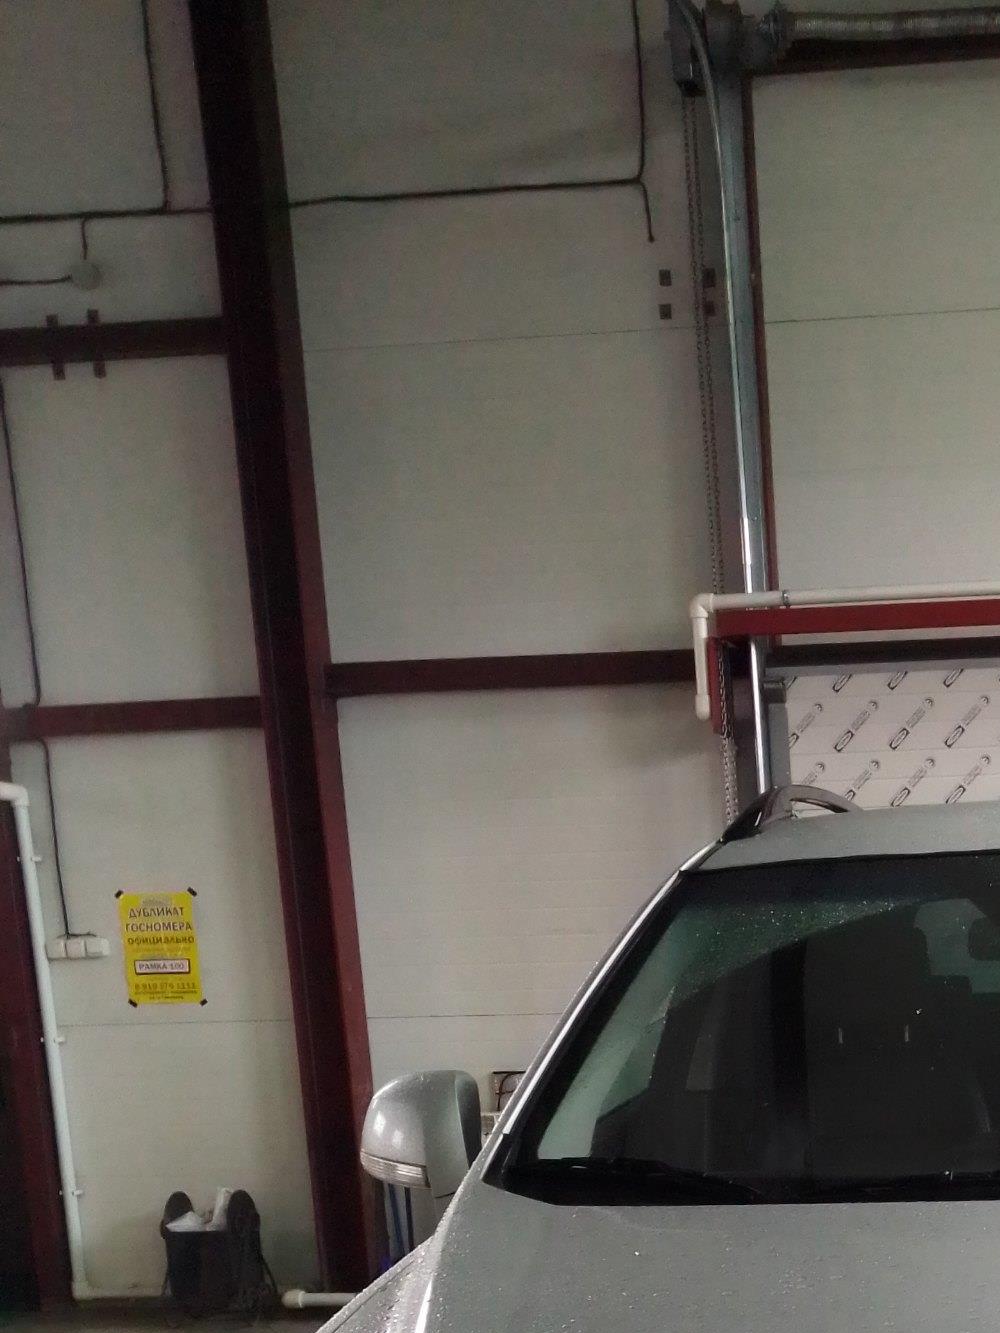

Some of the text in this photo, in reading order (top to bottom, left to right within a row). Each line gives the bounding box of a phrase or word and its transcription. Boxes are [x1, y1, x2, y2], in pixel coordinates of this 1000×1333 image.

[128, 907, 184, 918] ДУБЛИКАТ
[125, 922, 192, 932] ГОСНОМЕРА
[138, 963, 168, 971] РАМКА
